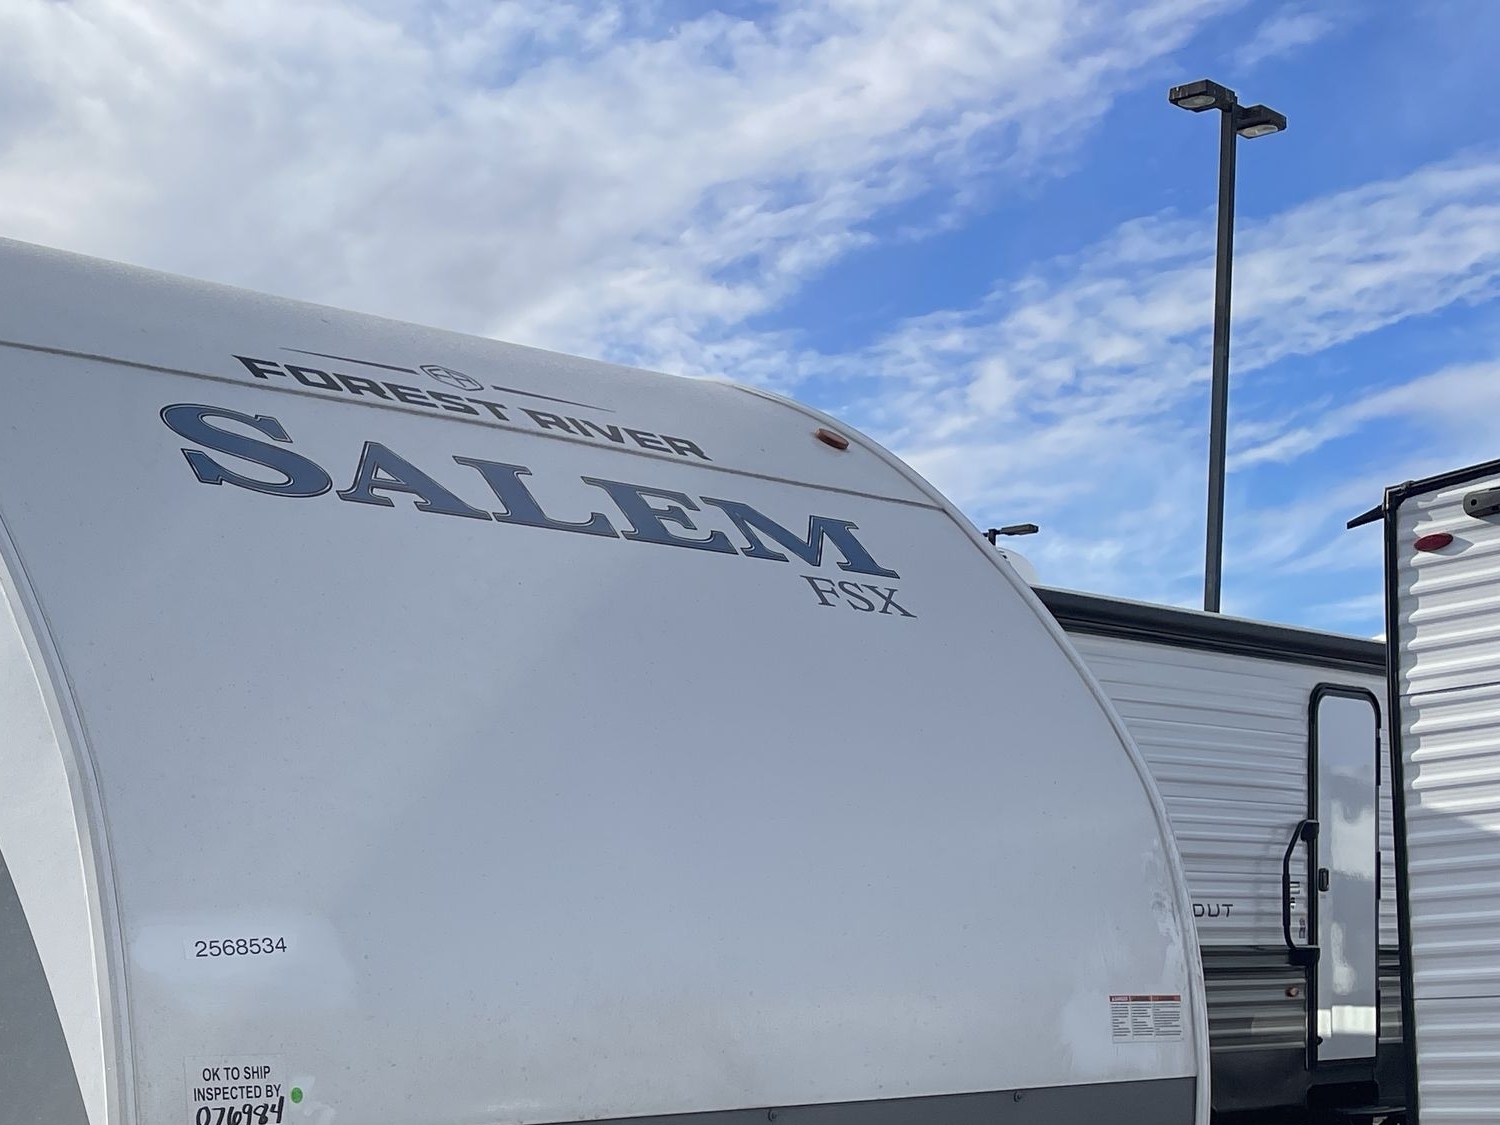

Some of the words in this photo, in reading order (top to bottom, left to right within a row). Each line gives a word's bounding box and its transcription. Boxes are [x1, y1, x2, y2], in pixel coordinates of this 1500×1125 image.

[232, 355, 508, 421] FOREST
[517, 410, 712, 461] RIVER
[159, 403, 900, 579] SALEM
[800, 574, 917, 619] FSX
[195, 937, 287, 957] 2568534
[202, 1067, 221, 1082] OK
[223, 1066, 241, 1081] TO
[243, 1065, 271, 1080] SHIP
[194, 1085, 262, 1102] INSPECTED
[265, 1083, 282, 1098] BY
